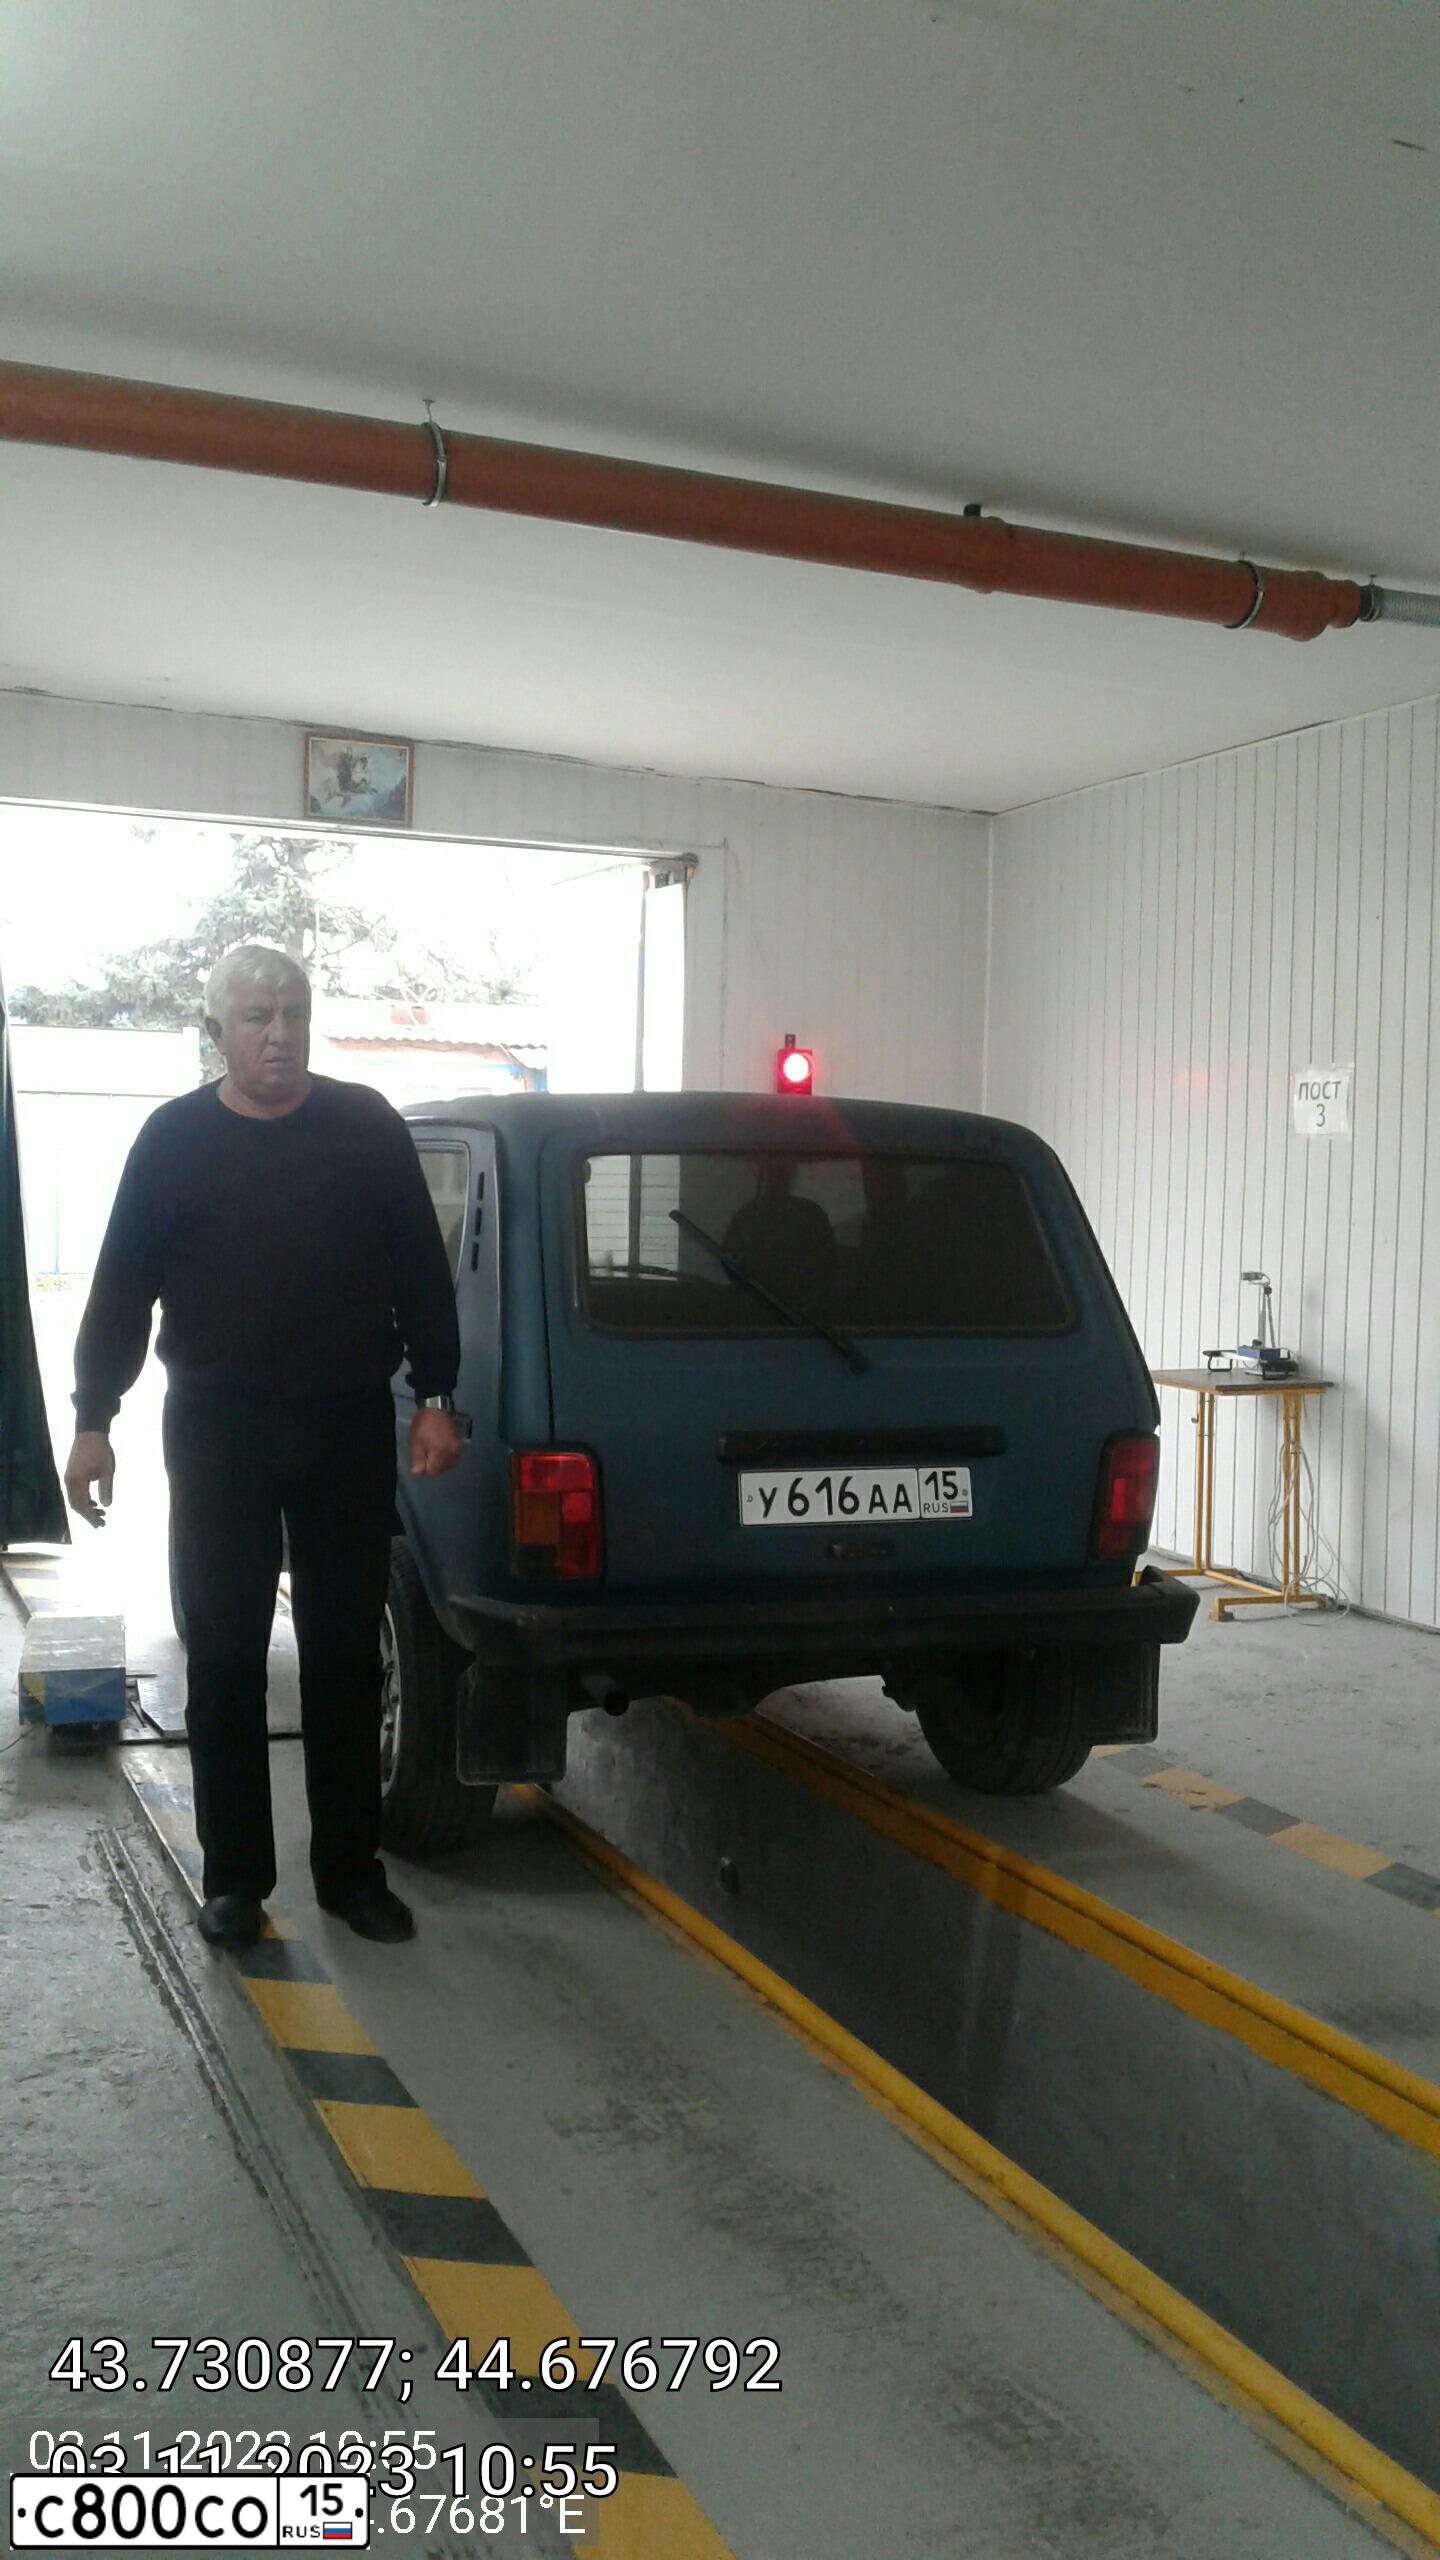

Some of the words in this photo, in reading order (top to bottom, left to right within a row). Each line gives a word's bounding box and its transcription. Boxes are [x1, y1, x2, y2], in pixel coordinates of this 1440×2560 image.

[1299, 1081, 1341, 1100] ПОСТ
[1316, 1103, 1326, 1127] 3
[924, 1470, 958, 1501] 15
[923, 1502, 949, 1513] RUS
